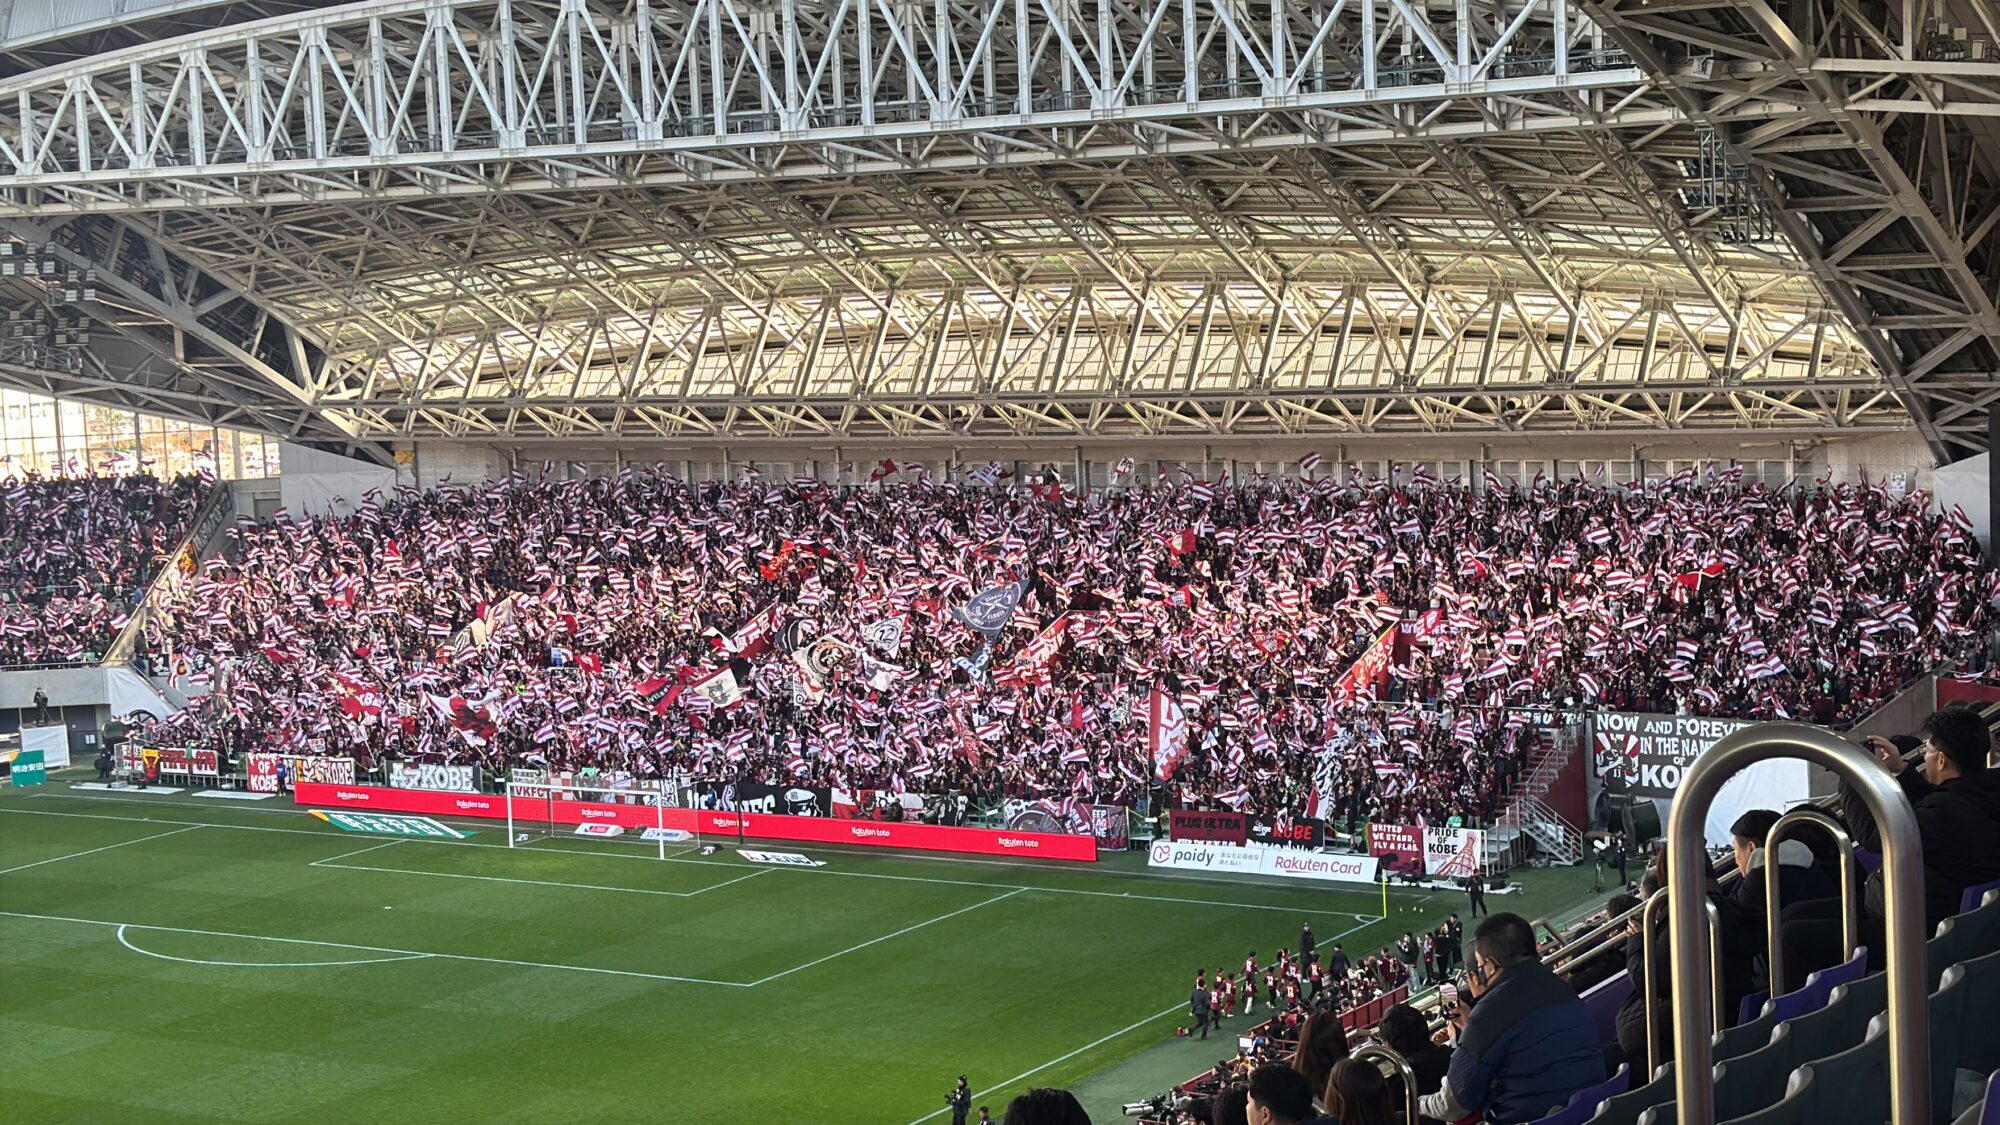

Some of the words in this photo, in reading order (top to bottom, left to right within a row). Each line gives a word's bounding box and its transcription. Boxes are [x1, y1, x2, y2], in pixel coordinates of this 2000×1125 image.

[1596, 714, 1639, 732] NOW
[1644, 721, 1672, 734] AND
[1676, 718, 1752, 738] FOREV
[1640, 736, 1652, 754] IN
[1656, 737, 1679, 756] THE
[1673, 756, 1686, 766] OF
[258, 760, 270, 774] OF
[250, 774, 278, 791] KOBE
[515, 785, 544, 797] VKFC
[1175, 816, 1201, 829] PLUS
[1204, 818, 1241, 830] ULTRA
[1372, 824, 1402, 832] UNITED
[852, 827, 875, 837] Rakuten
[1372, 832, 1385, 840] WE
[1428, 828, 1459, 837] PRIDE
[998, 837, 1024, 847] Rakuten
[1374, 841, 1387, 849] FLY
[1428, 843, 1458, 854] KOBE
[1174, 849, 1215, 866] paidy
[1275, 856, 1328, 873] Rakuten
[1330, 860, 1362, 875] Card
